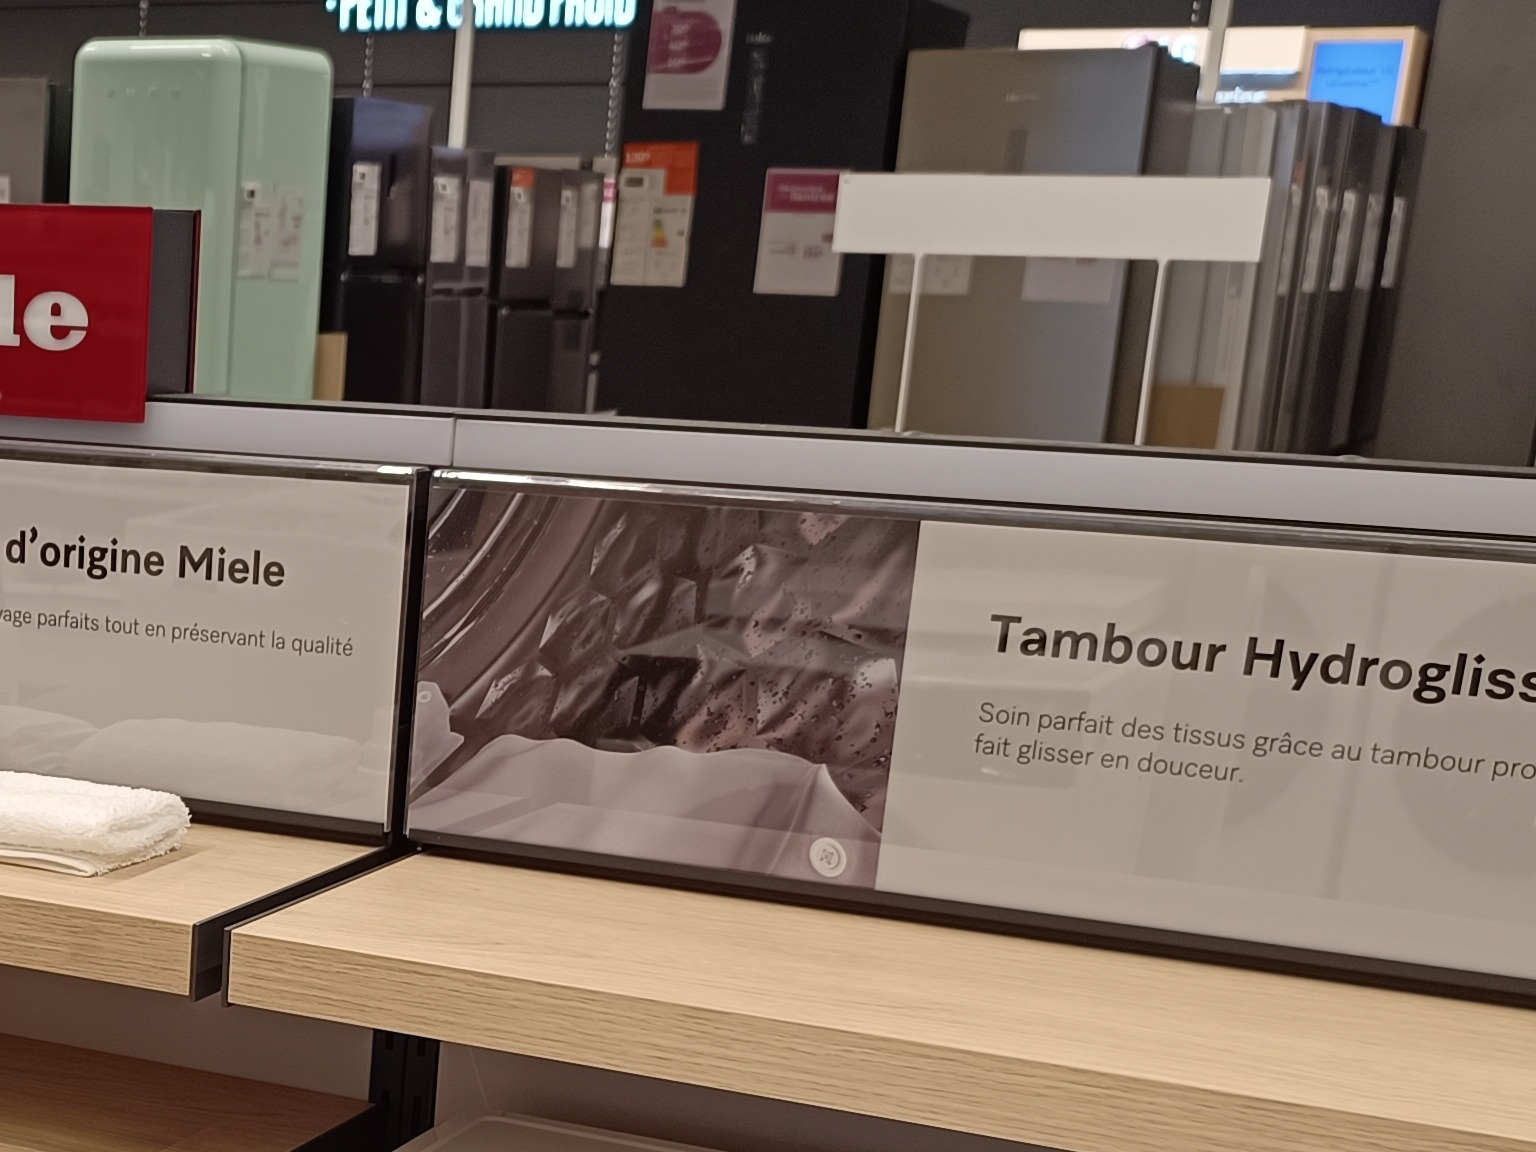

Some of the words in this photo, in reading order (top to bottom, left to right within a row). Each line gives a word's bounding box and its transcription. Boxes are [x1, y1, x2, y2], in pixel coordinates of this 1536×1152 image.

[5, 526, 164, 580] d'origine
[178, 545, 285, 587] Miele
[37, 608, 99, 634] parfaits
[104, 615, 139, 636] tout
[145, 622, 165, 637] en
[171, 625, 265, 651] préservant
[270, 631, 286, 650] la
[291, 635, 353, 657] qualité
[990, 615, 1226, 673] Tambour
[974, 733, 1010, 758] fait
[1016, 740, 1093, 766] glisser
[1100, 751, 1129, 770] en
[1137, 751, 1244, 783] douceur.
[979, 702, 1030, 727] Soin
[1037, 711, 1113, 736] parfait
[1121, 717, 1165, 741] des
[1173, 723, 1245, 749] tissus
[1252, 732, 1323, 758] grâce
[1331, 743, 1361, 762] au
[1371, 743, 1485, 775] tambour
[1492, 756, 1536, 782] pro
